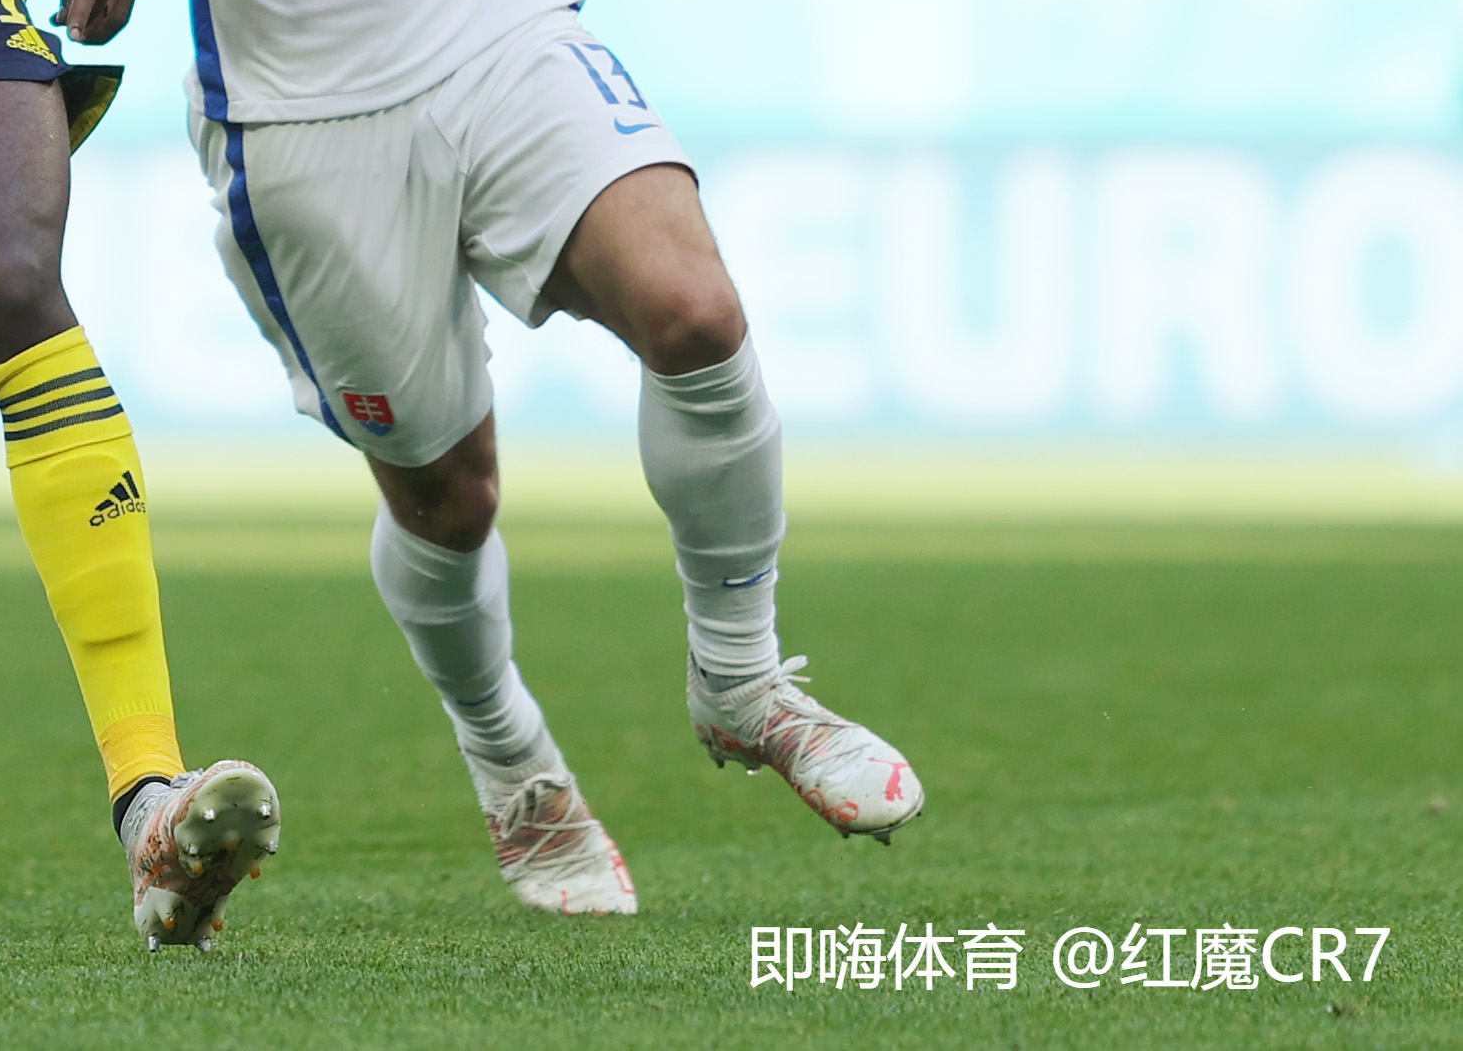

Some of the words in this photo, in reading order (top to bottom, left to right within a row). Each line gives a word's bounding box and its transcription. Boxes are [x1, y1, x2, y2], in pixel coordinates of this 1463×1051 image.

[6, 38, 58, 65] adidas
[559, 42, 648, 111] 13
[710, 144, 1463, 422] EURO
[89, 497, 146, 527] adidas
